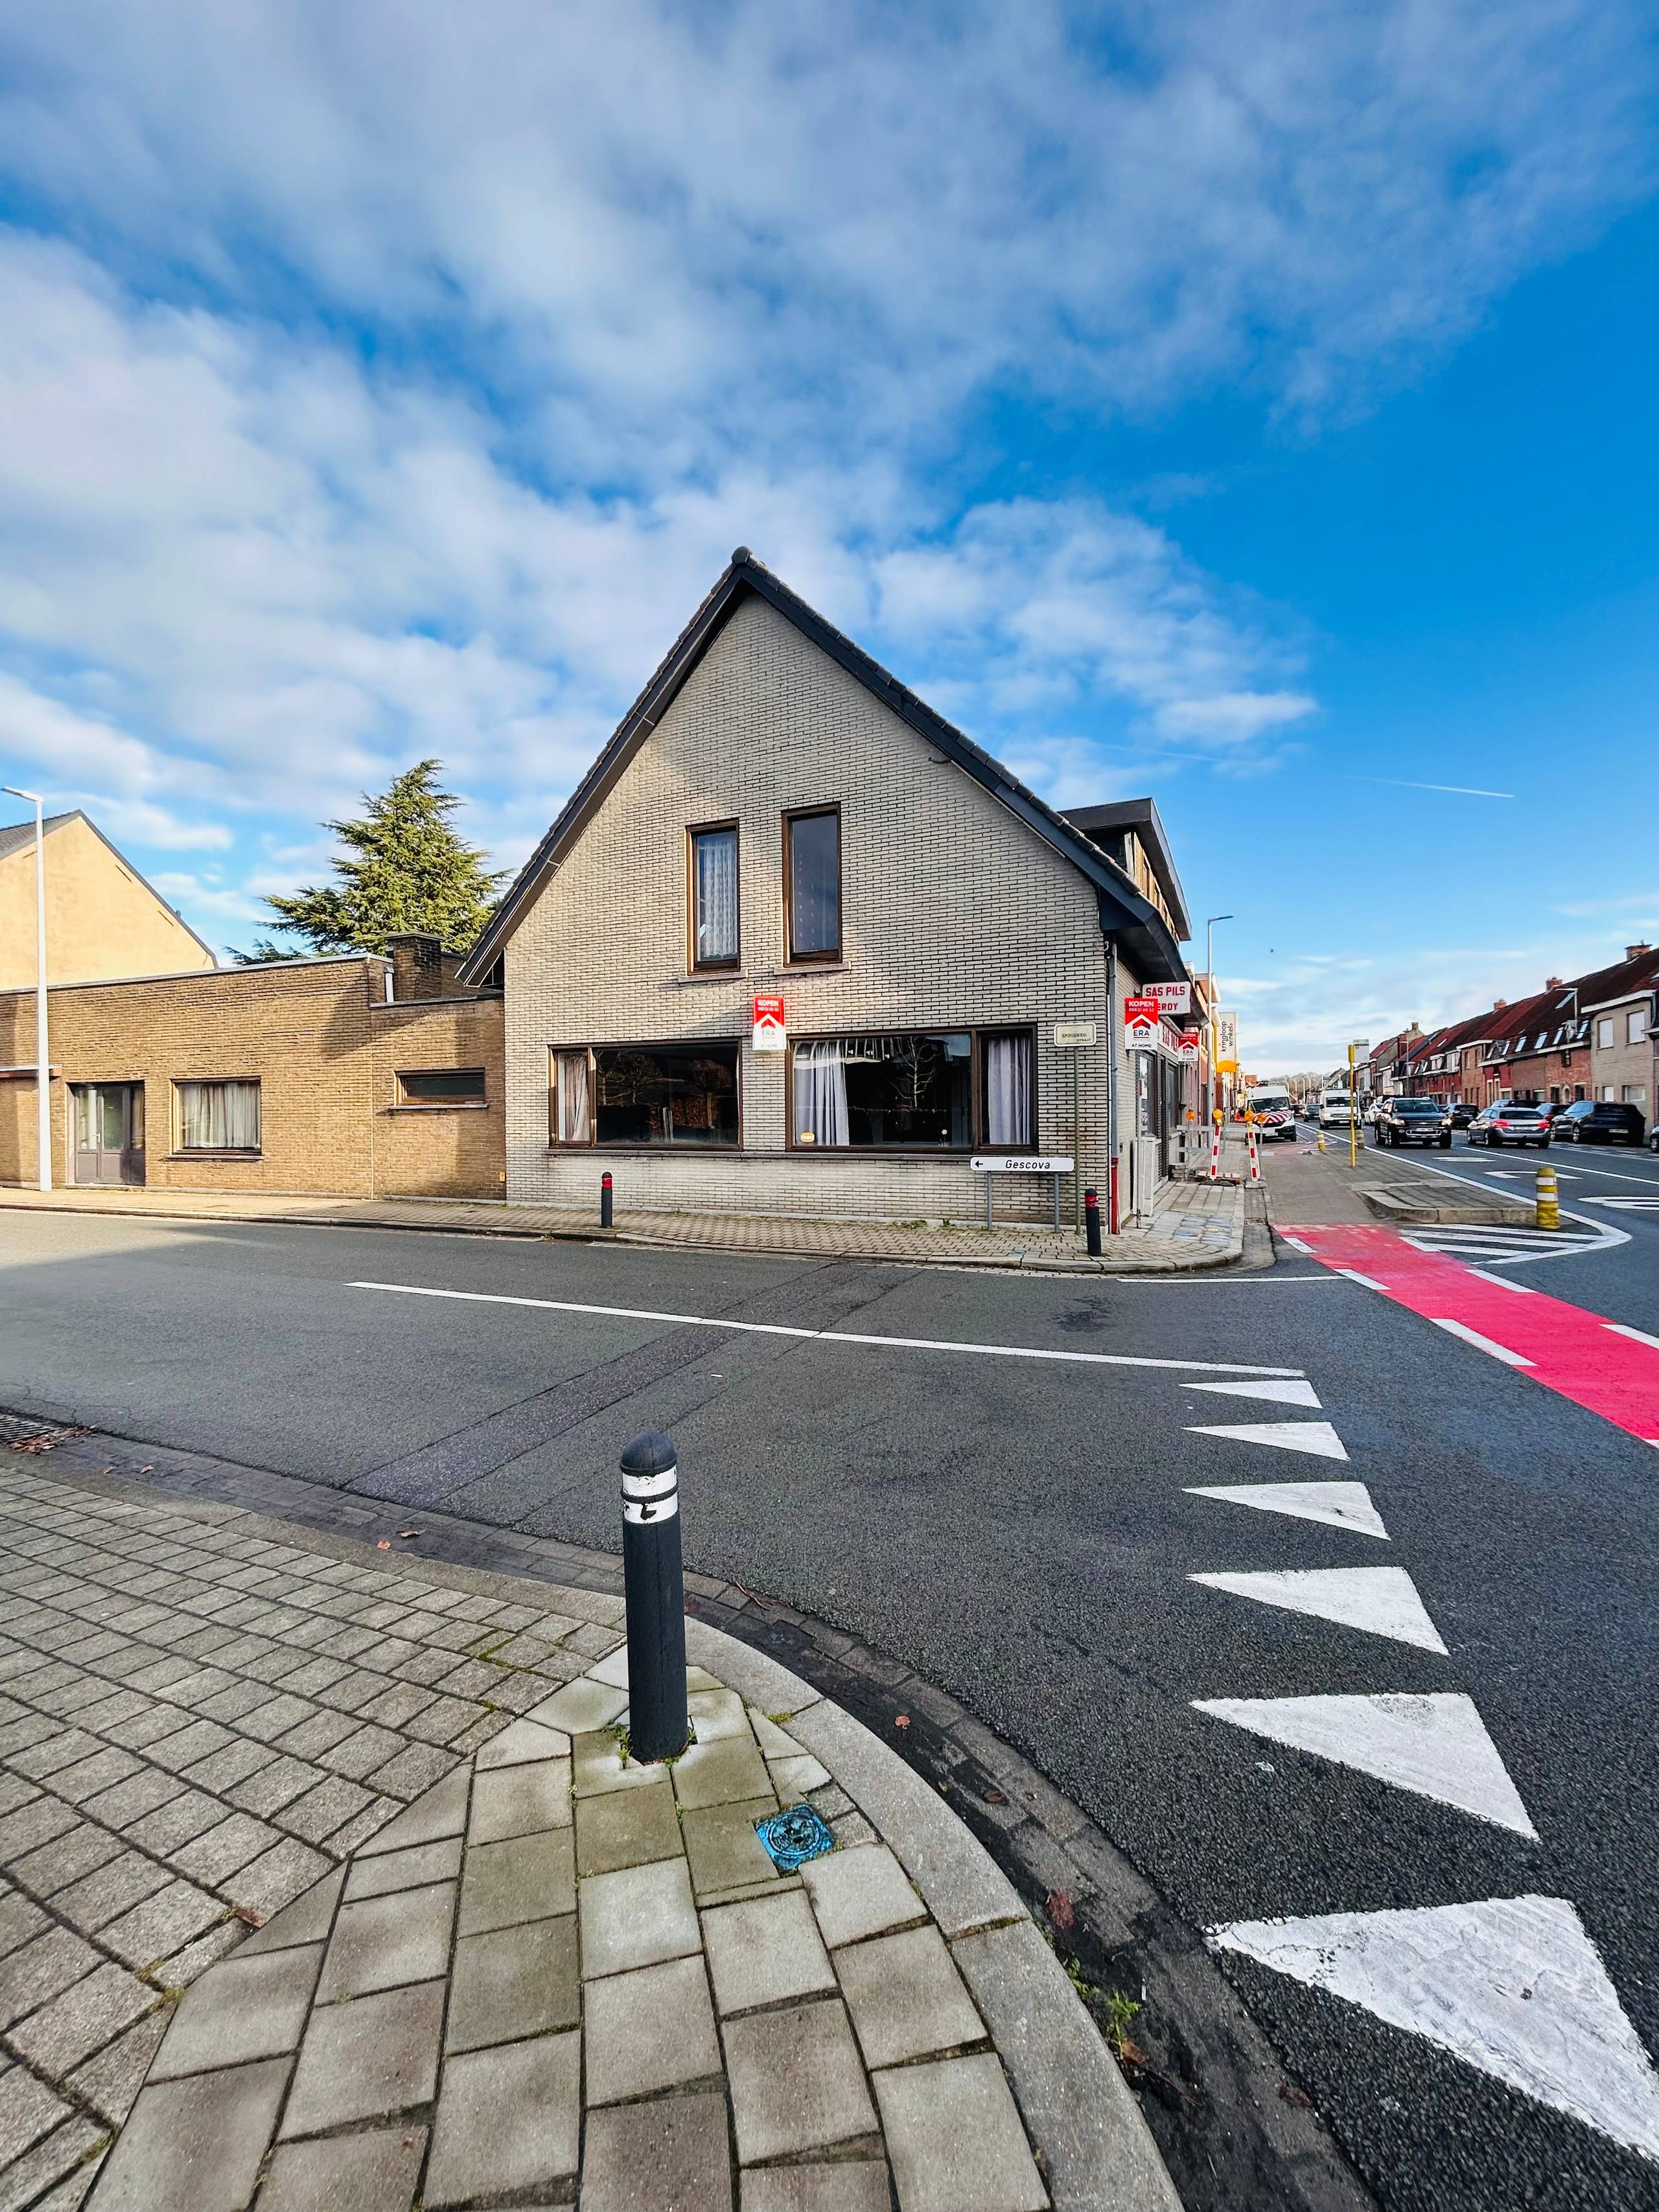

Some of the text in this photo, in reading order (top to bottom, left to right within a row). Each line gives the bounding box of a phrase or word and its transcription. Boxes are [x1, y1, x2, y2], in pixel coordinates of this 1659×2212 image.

[1146, 986, 1185, 997] SAS PILS
[1005, 1159, 1050, 1169] Gescova
